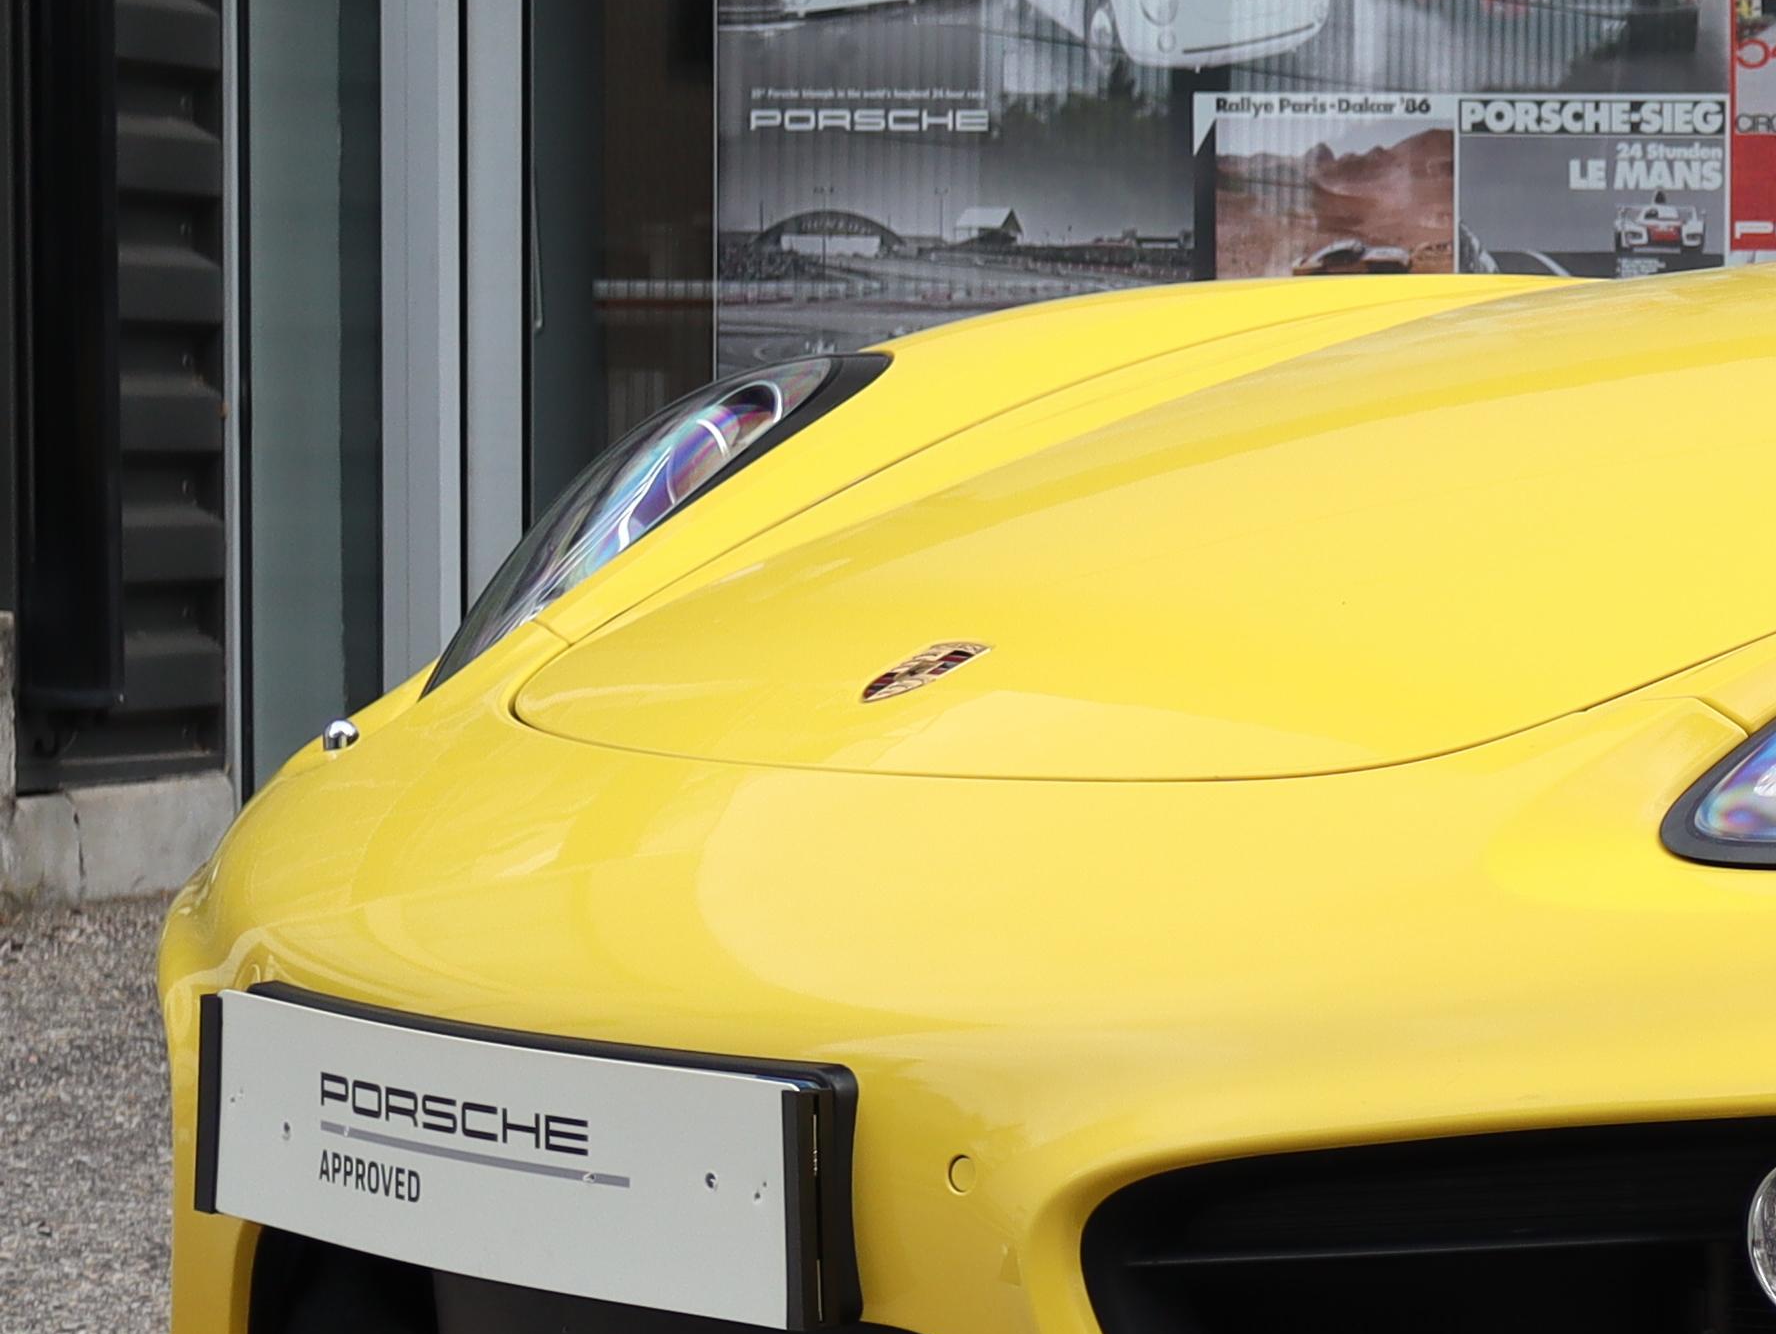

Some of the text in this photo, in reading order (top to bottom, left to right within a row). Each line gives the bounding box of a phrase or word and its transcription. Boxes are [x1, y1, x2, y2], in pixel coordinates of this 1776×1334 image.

[750, 109, 989, 132] PORSCHE
[1216, 98, 1273, 117] Rallye
[1400, 97, 1431, 114] '86
[1460, 100, 1723, 133] PORSCHE-SIEG
[1616, 142, 1723, 160] 24 Stunden
[1569, 158, 1723, 191] LE MANS
[320, 1071, 589, 1157] PORSCHE
[318, 1149, 422, 1204] APPROVED
